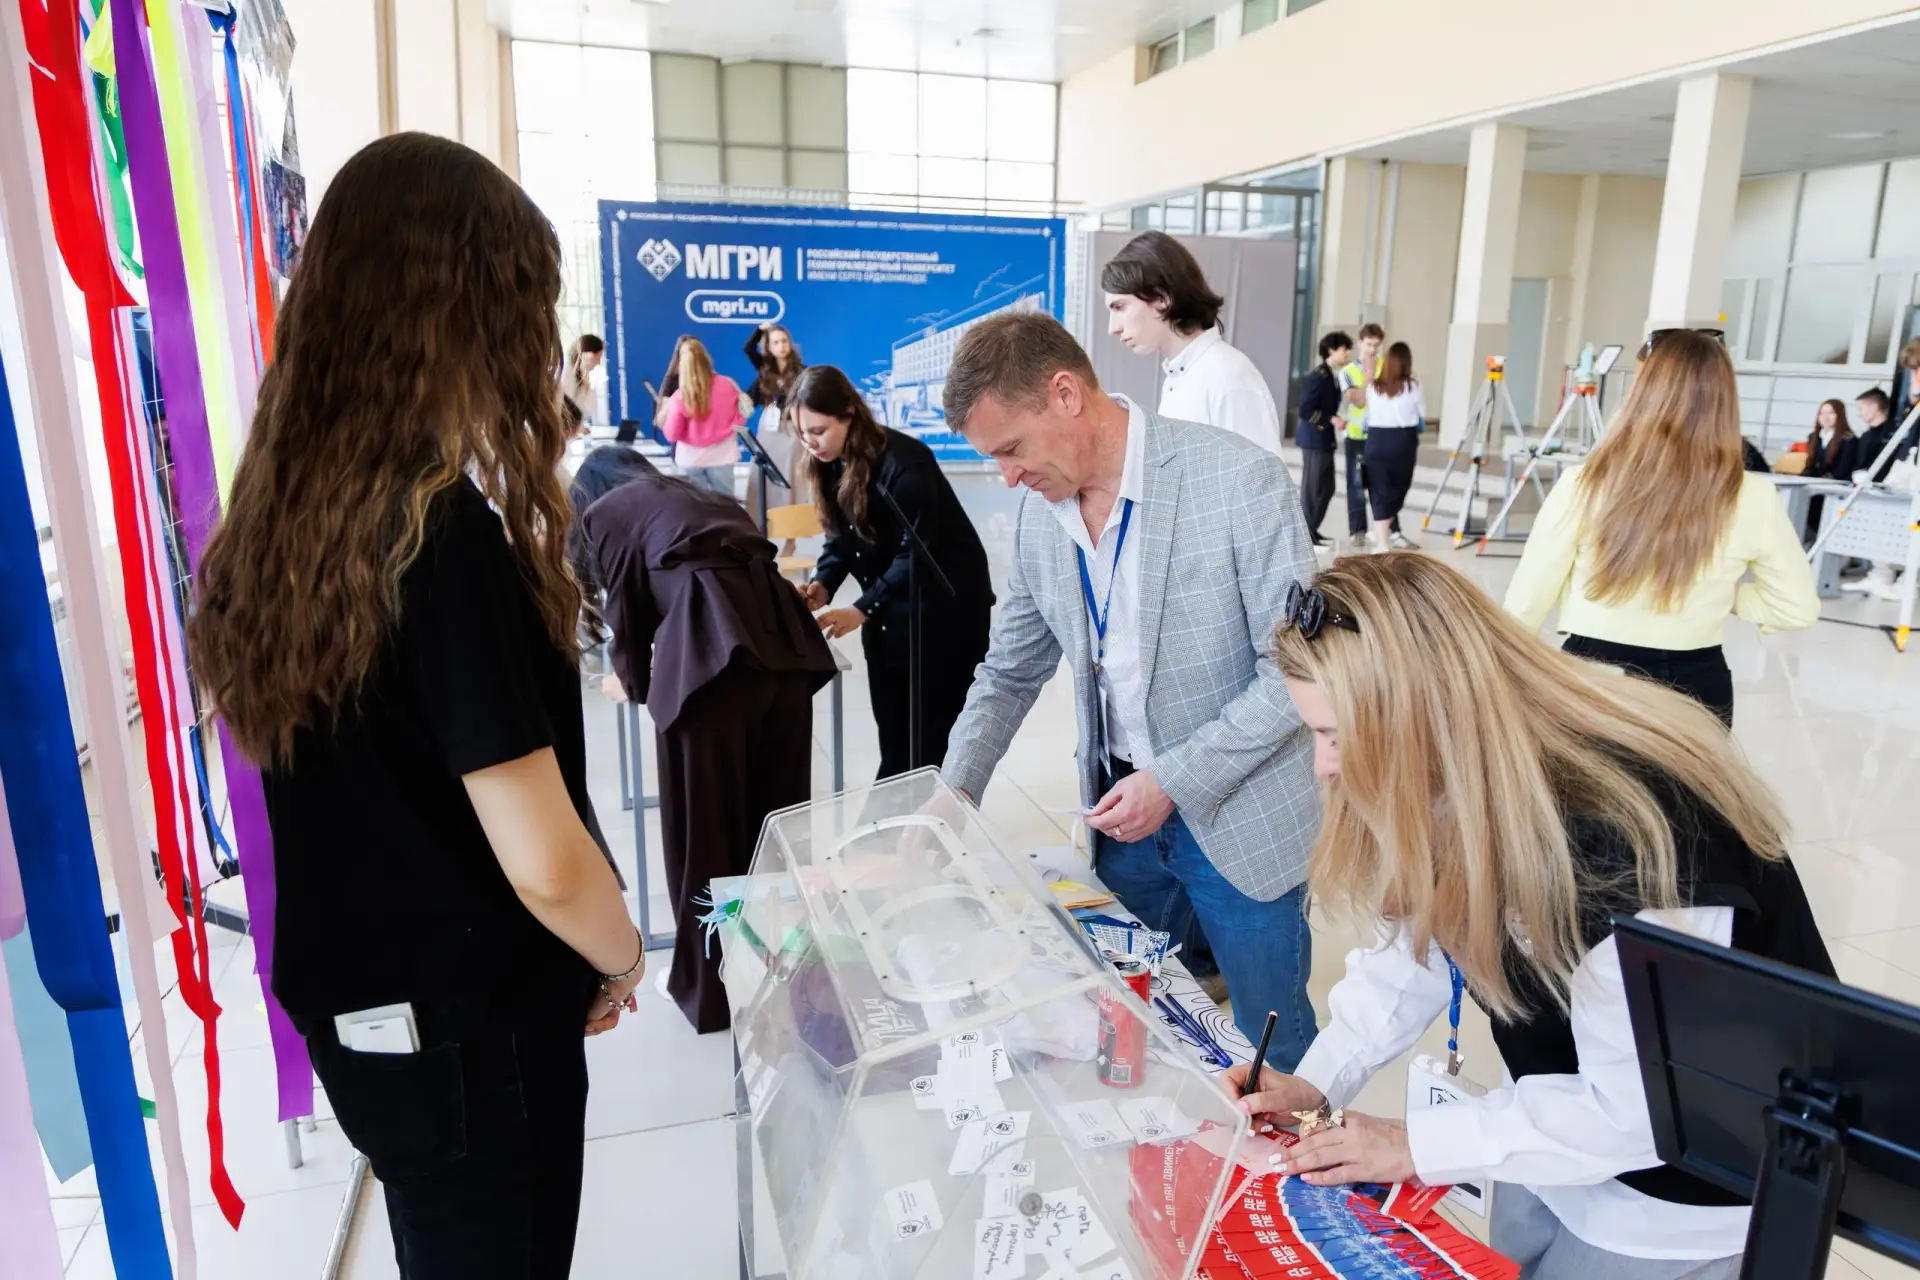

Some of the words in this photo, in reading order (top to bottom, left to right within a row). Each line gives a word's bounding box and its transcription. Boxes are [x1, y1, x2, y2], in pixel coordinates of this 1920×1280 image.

[685, 243, 783, 281] МГРИ
[702, 297, 768, 318] mgri.ru
[1163, 1143, 1174, 1181] ДВИЖЕН
